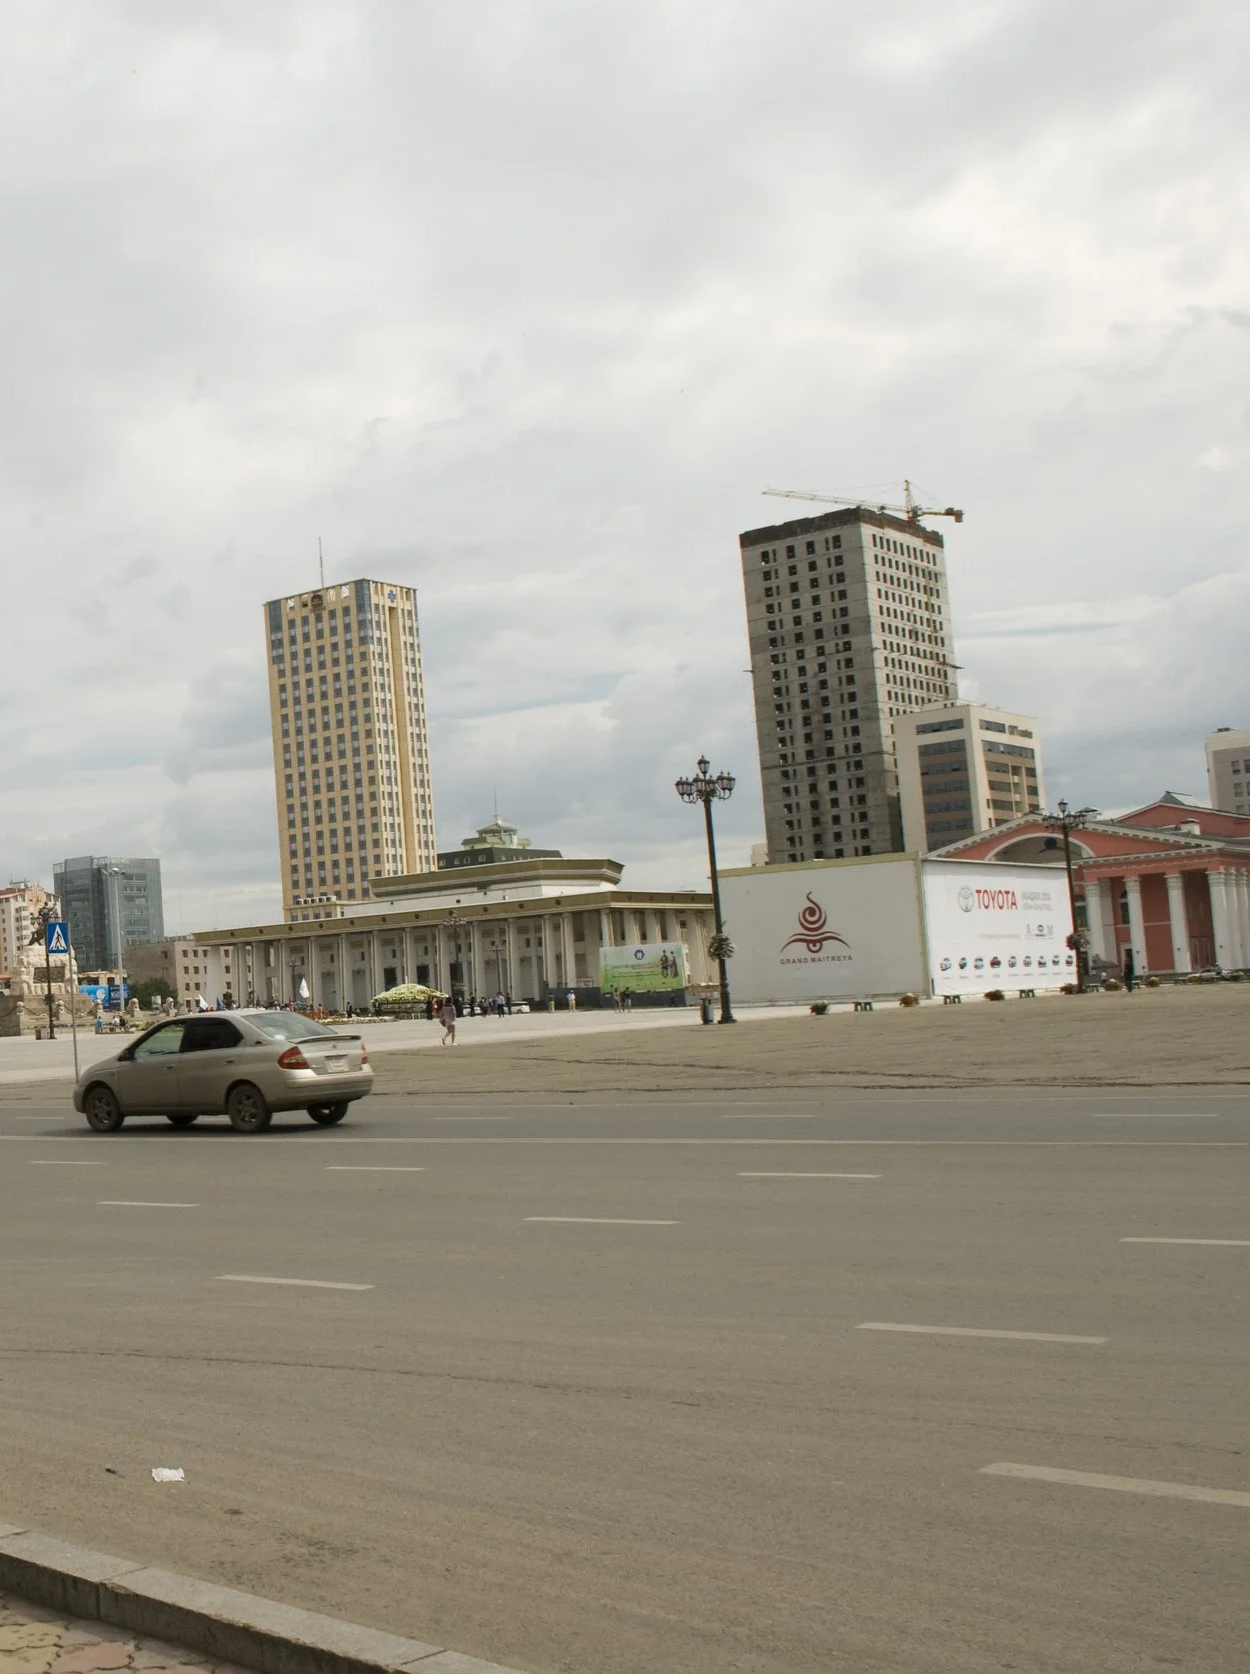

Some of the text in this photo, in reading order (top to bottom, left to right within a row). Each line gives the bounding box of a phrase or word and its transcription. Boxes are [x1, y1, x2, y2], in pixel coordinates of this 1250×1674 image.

[975, 889, 1018, 910] TOYOTA
[780, 955, 853, 965] GRAND MAITREYA
